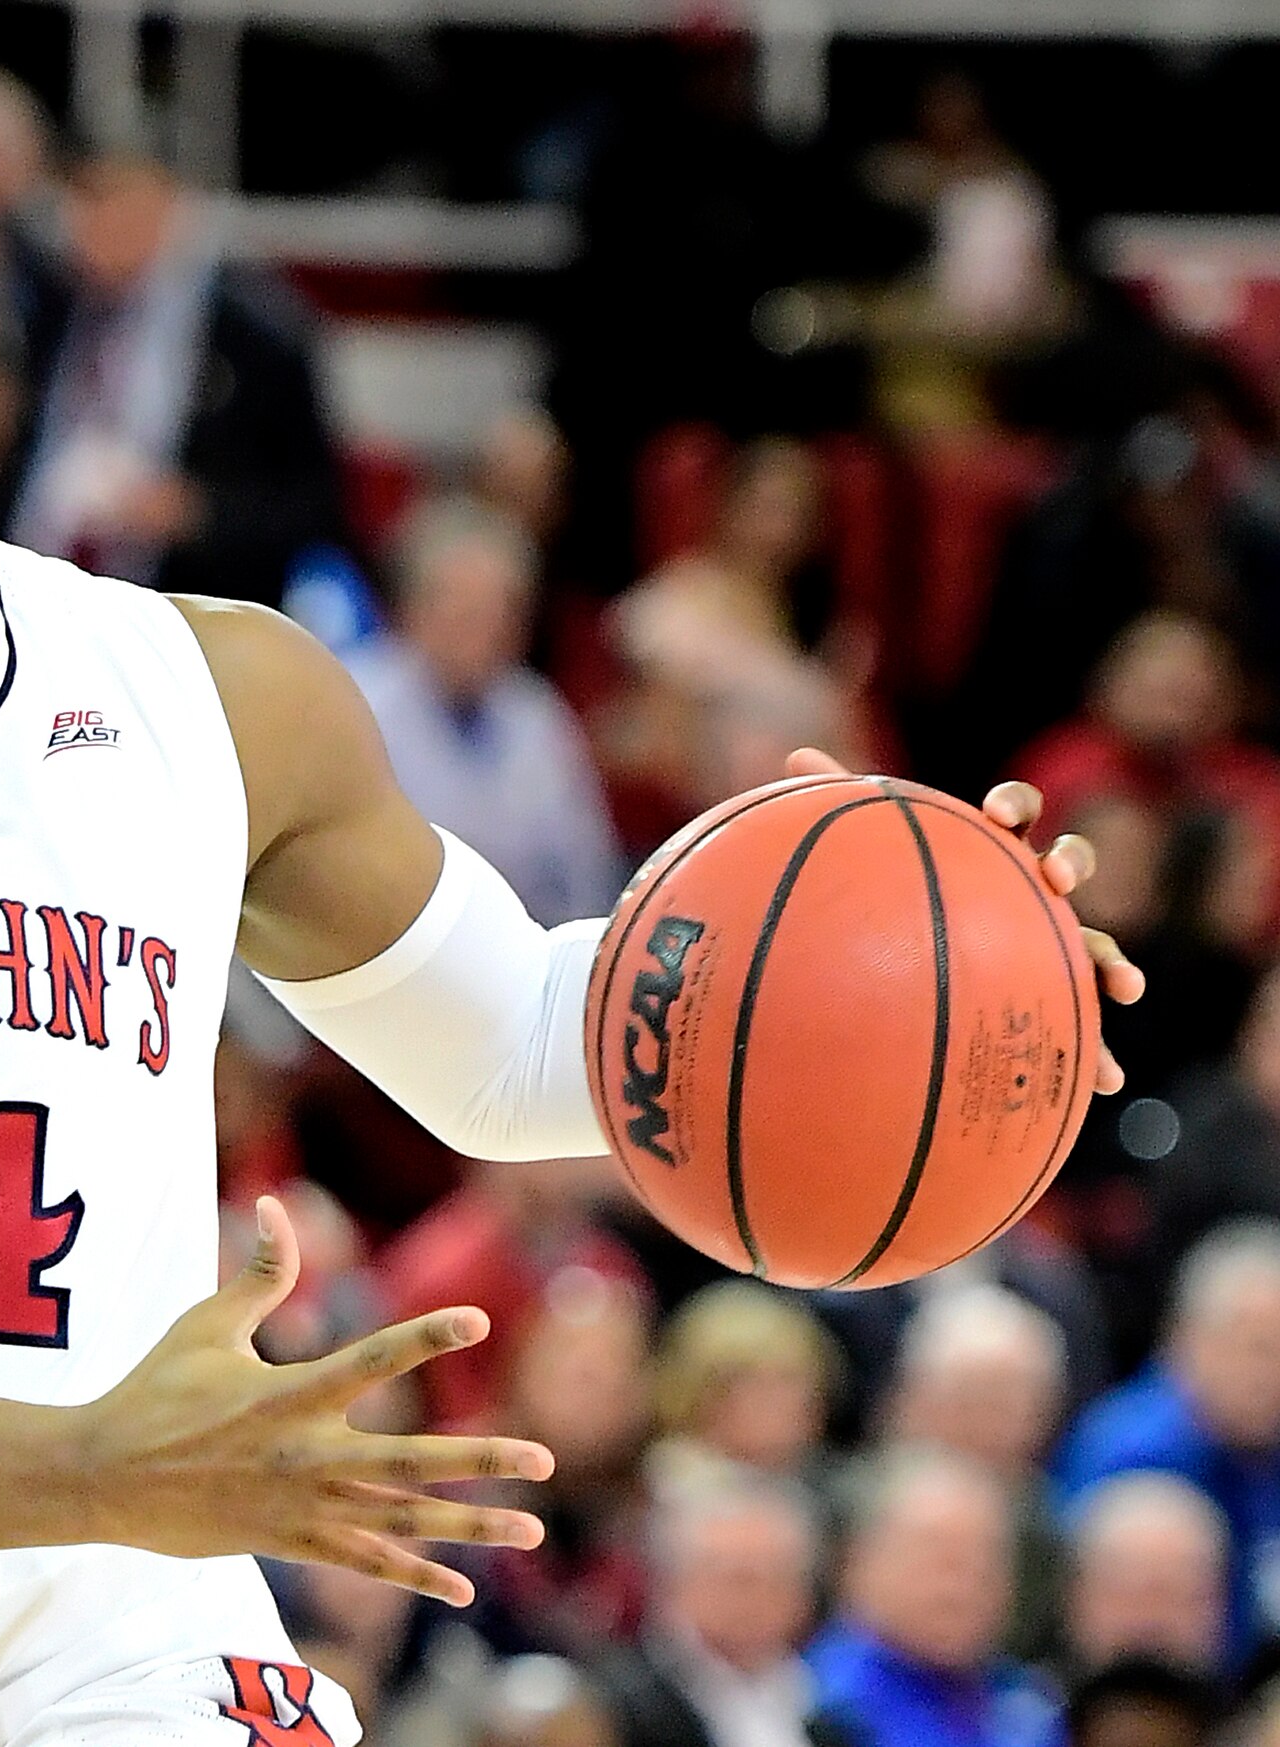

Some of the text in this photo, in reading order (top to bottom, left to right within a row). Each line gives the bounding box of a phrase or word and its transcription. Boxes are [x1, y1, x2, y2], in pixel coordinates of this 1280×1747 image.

[52, 710, 104, 730] BIG
[47, 726, 122, 748] EAST
[623, 916, 705, 1168] NCAA
